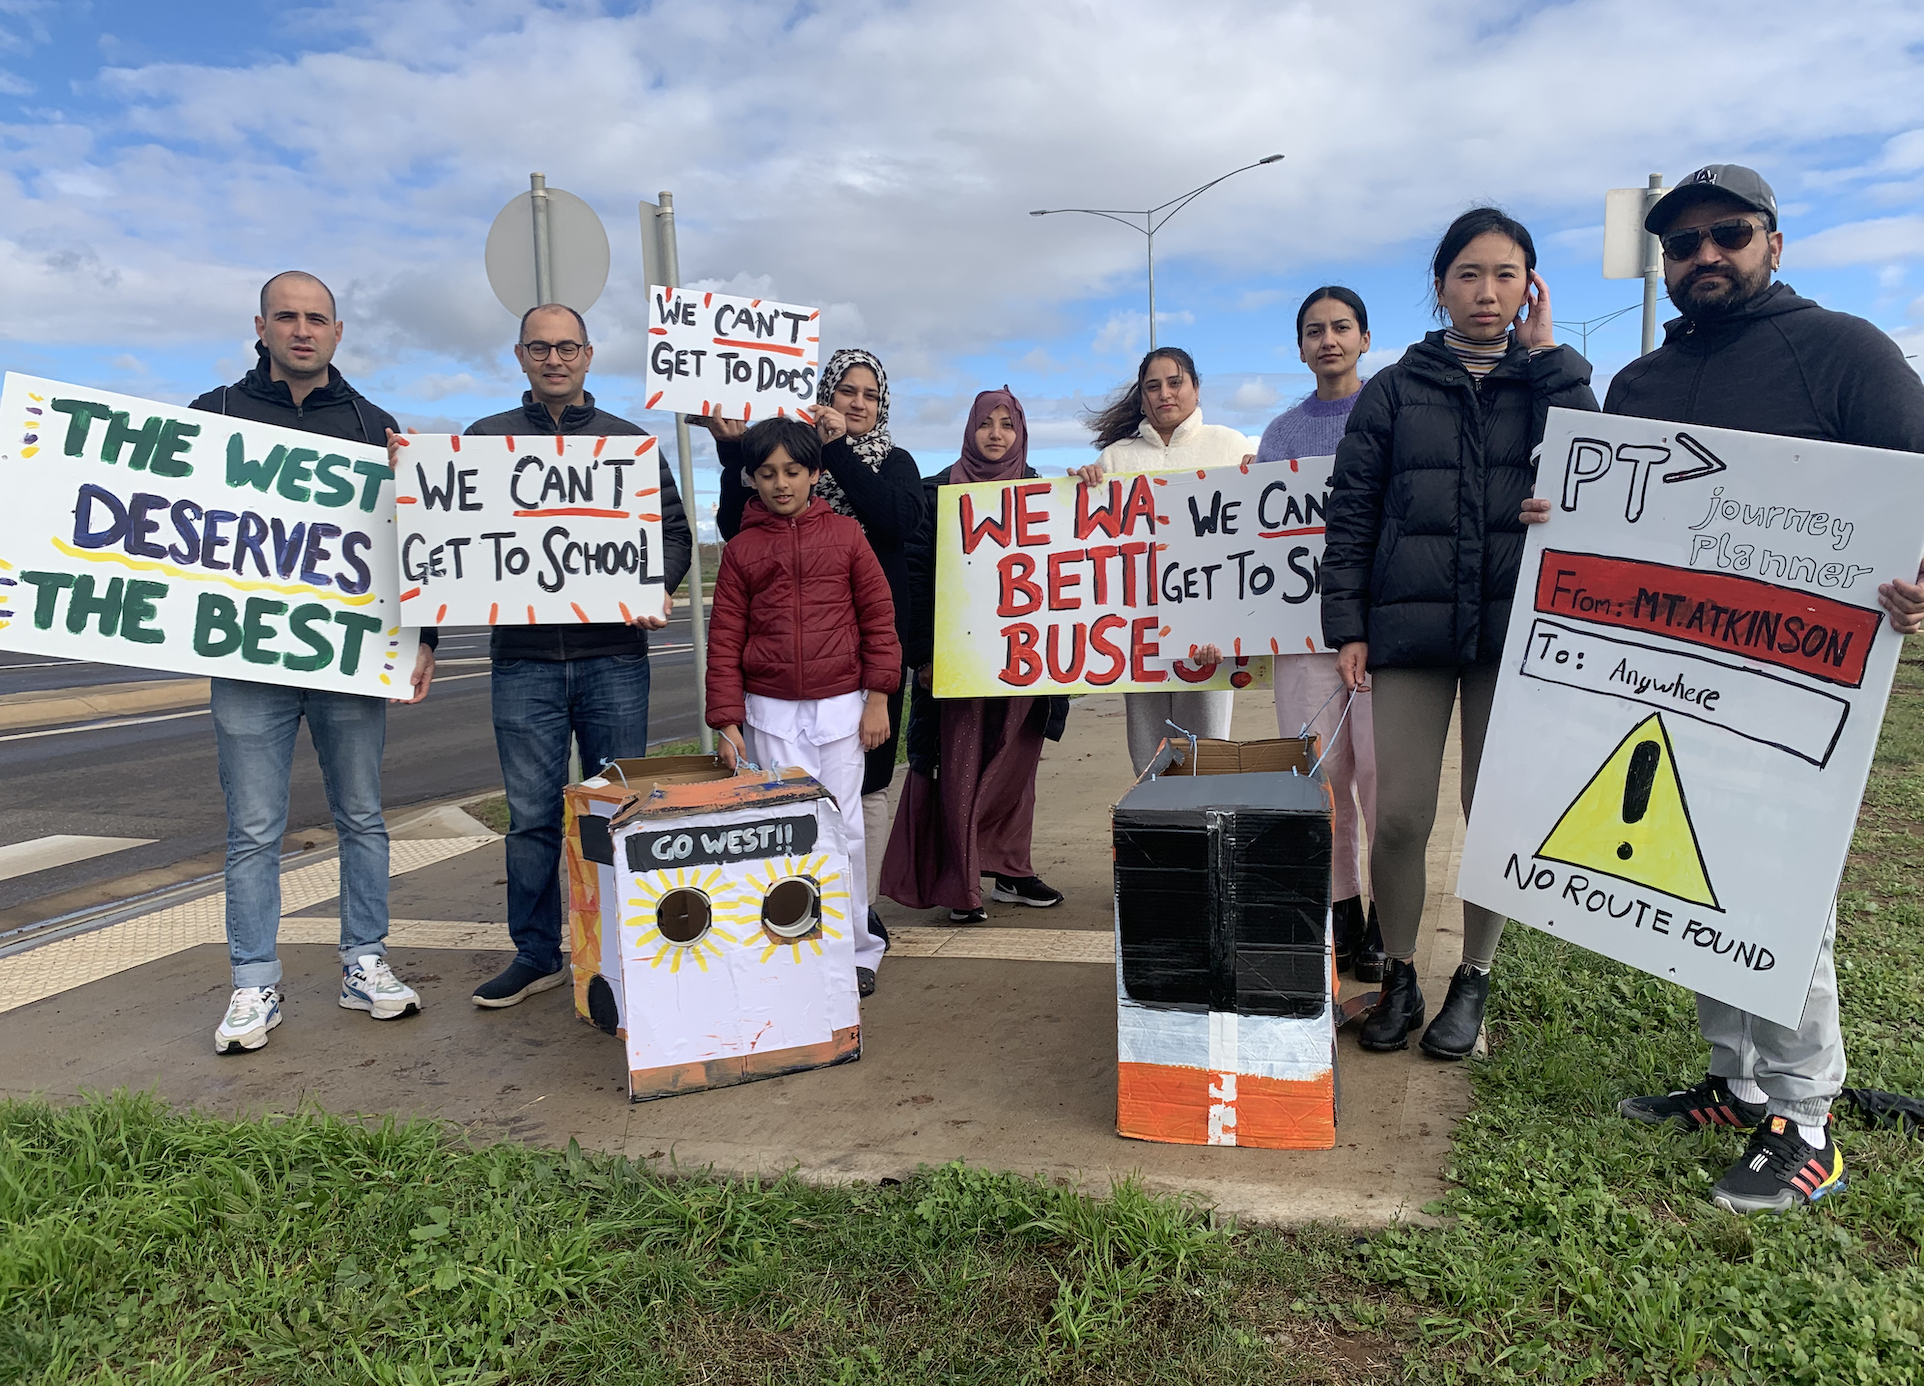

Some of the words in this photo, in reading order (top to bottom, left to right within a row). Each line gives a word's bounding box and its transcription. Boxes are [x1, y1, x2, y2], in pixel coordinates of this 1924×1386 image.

[657, 294, 697, 326] WE
[715, 304, 810, 344] CAN'T
[652, 341, 707, 382] GET
[716, 352, 752, 385] TO
[756, 357, 815, 400] DOCS
[51, 397, 201, 477] THE
[226, 432, 395, 513] WEST
[416, 460, 483, 511] WE
[511, 455, 635, 509] CAN'T
[71, 483, 372, 593] DESERVES
[959, 482, 1052, 555] WE
[1074, 474, 1156, 541] WA
[1188, 490, 1242, 537] WE
[1688, 486, 1854, 550] journey
[403, 533, 471, 585] GET
[480, 532, 530, 582] TO
[537, 526, 664, 593] SCHOOL
[996, 541, 1157, 618] BETT
[1162, 562, 1222, 604] GET
[1227, 550, 1275, 600] TO
[20, 571, 169, 644] THE
[192, 592, 382, 676] BEST
[1550, 569, 1624, 618] From:
[1537, 633, 1585, 670] To:
[1609, 658, 1720, 712] Anywhere
[651, 834, 694, 862] GO
[700, 823, 794, 855] WEST!!
[1504, 853, 1555, 891] NO
[1562, 875, 1673, 935] ROUTE
[1682, 920, 1776, 971] FOUND
